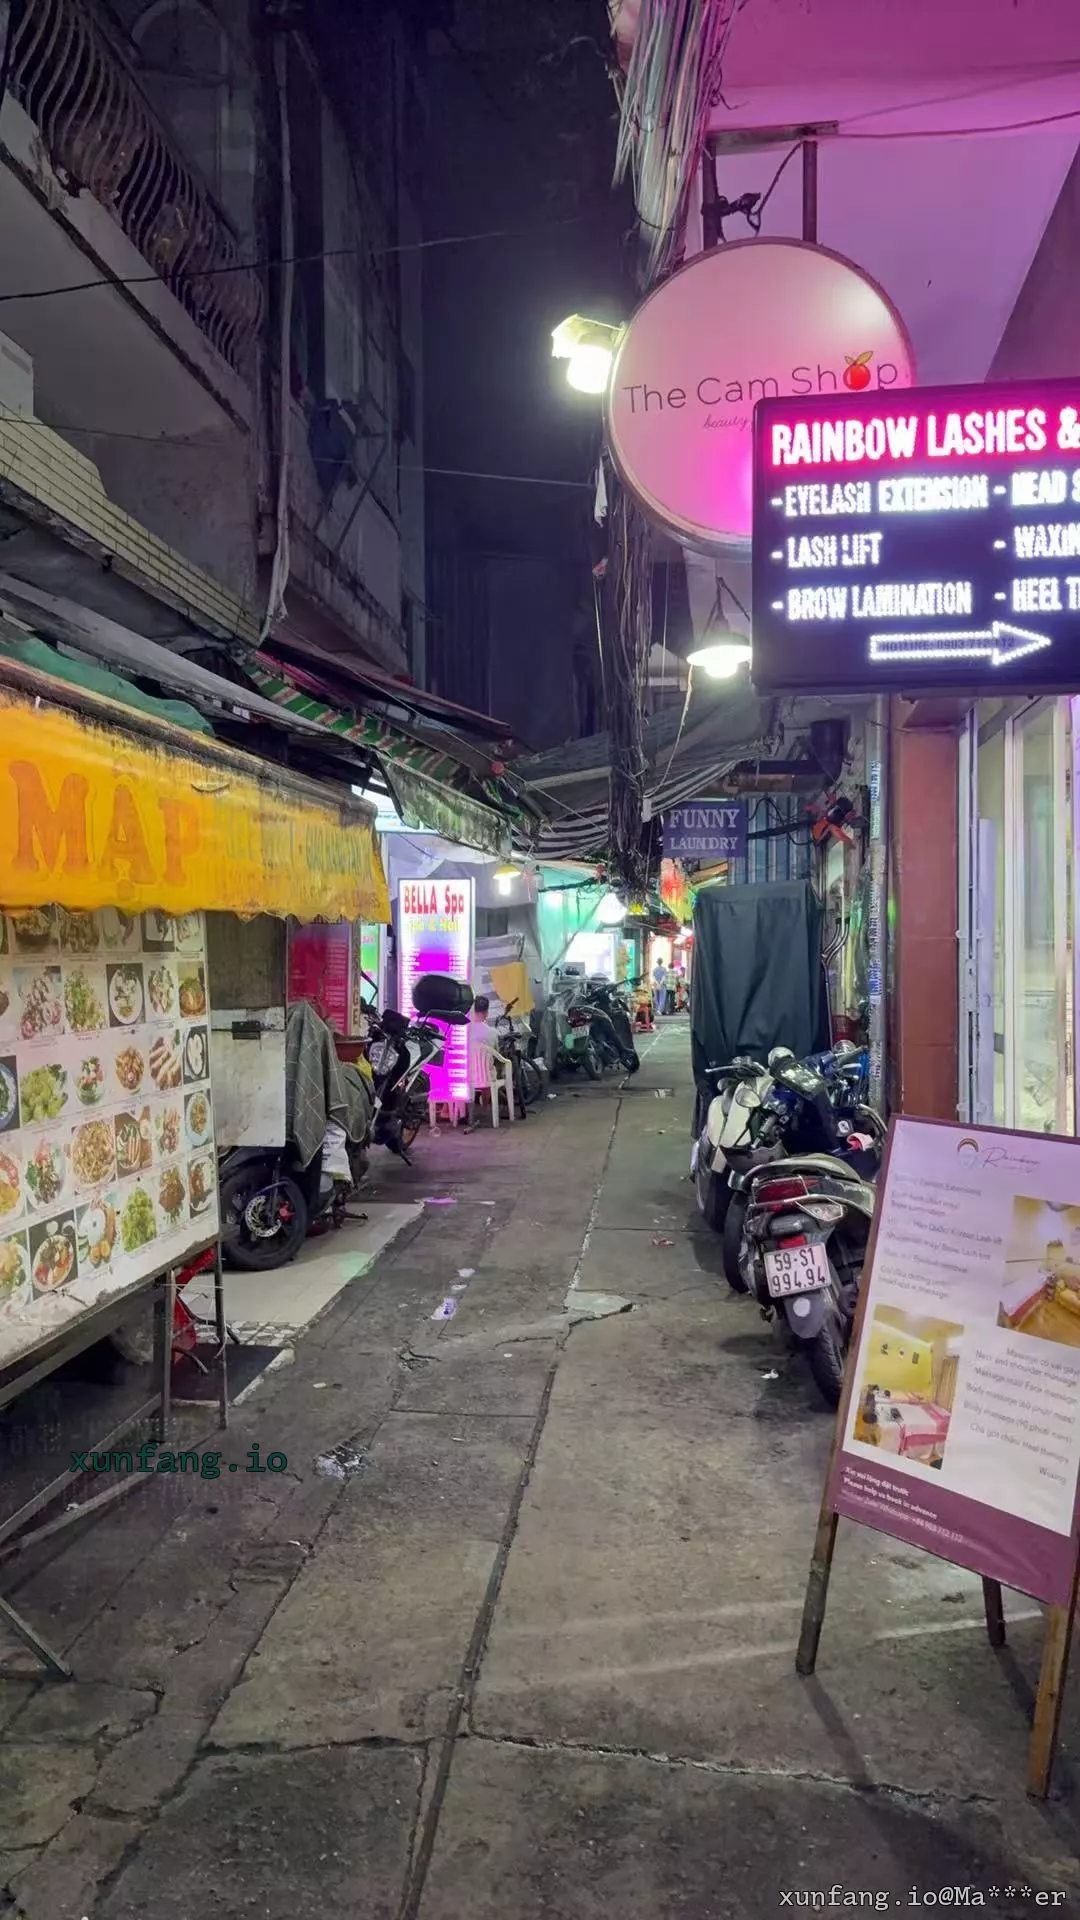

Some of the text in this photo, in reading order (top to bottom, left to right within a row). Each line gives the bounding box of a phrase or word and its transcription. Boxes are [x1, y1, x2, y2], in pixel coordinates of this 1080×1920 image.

[623, 384, 687, 414] The
[697, 377, 779, 405] Cam
[771, 405, 1080, 465] RAINBOW LASHES &
[785, 474, 989, 517] EYELASH EXTENSION
[1012, 468, 1067, 506] HEAD
[787, 532, 883, 568] LASH LIFT
[787, 580, 972, 621] BROW LAMINATION
[1012, 576, 1063, 612] HEEL
[668, 808, 740, 829] FUNNY
[669, 836, 739, 851] LAUNDRY
[404, 884, 438, 915] BELLA
[444, 884, 465, 922] Spa
[771, 1265, 826, 1293] 994.94
